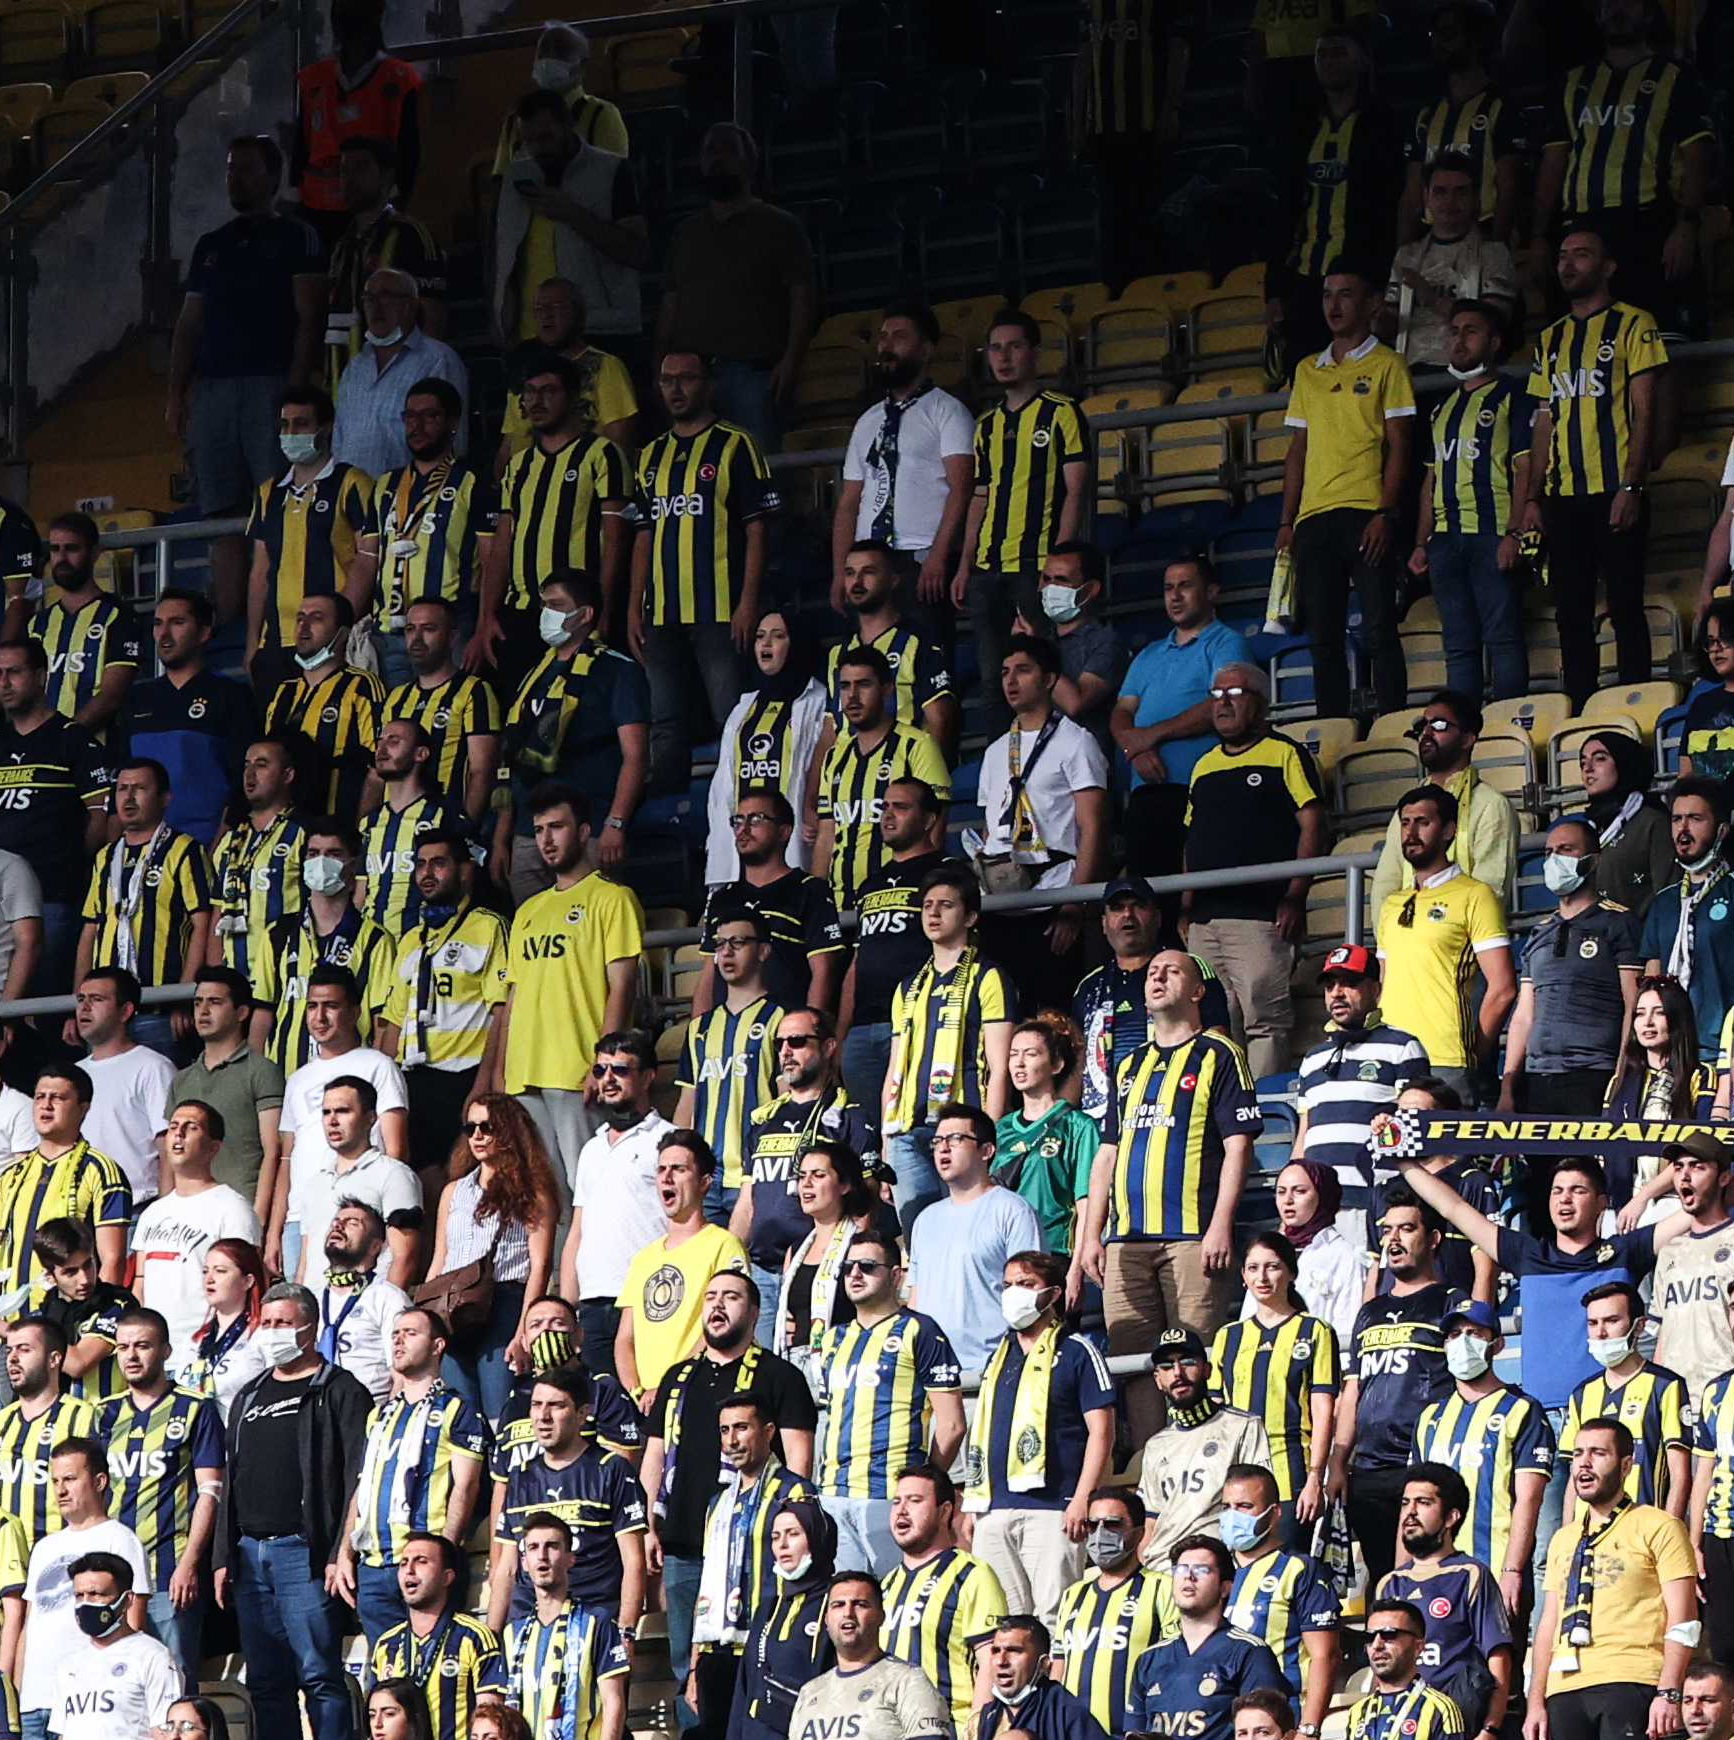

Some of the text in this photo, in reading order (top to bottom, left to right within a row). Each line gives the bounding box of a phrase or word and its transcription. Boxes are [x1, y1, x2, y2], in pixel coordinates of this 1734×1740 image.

[1578, 104, 1635, 129] AVIS
[1550, 367, 1604, 404] AVIS
[651, 493, 704, 520] avea
[47, 652, 87, 673] VIS
[740, 758, 780, 780] avea
[1664, 1275, 1719, 1309] AVIS
[828, 1364, 878, 1392] AVIS
[1429, 1441, 1480, 1468] AVIS
[1063, 1626, 1127, 1650] AVIS
[1152, 1710, 1206, 1737] AVIS
